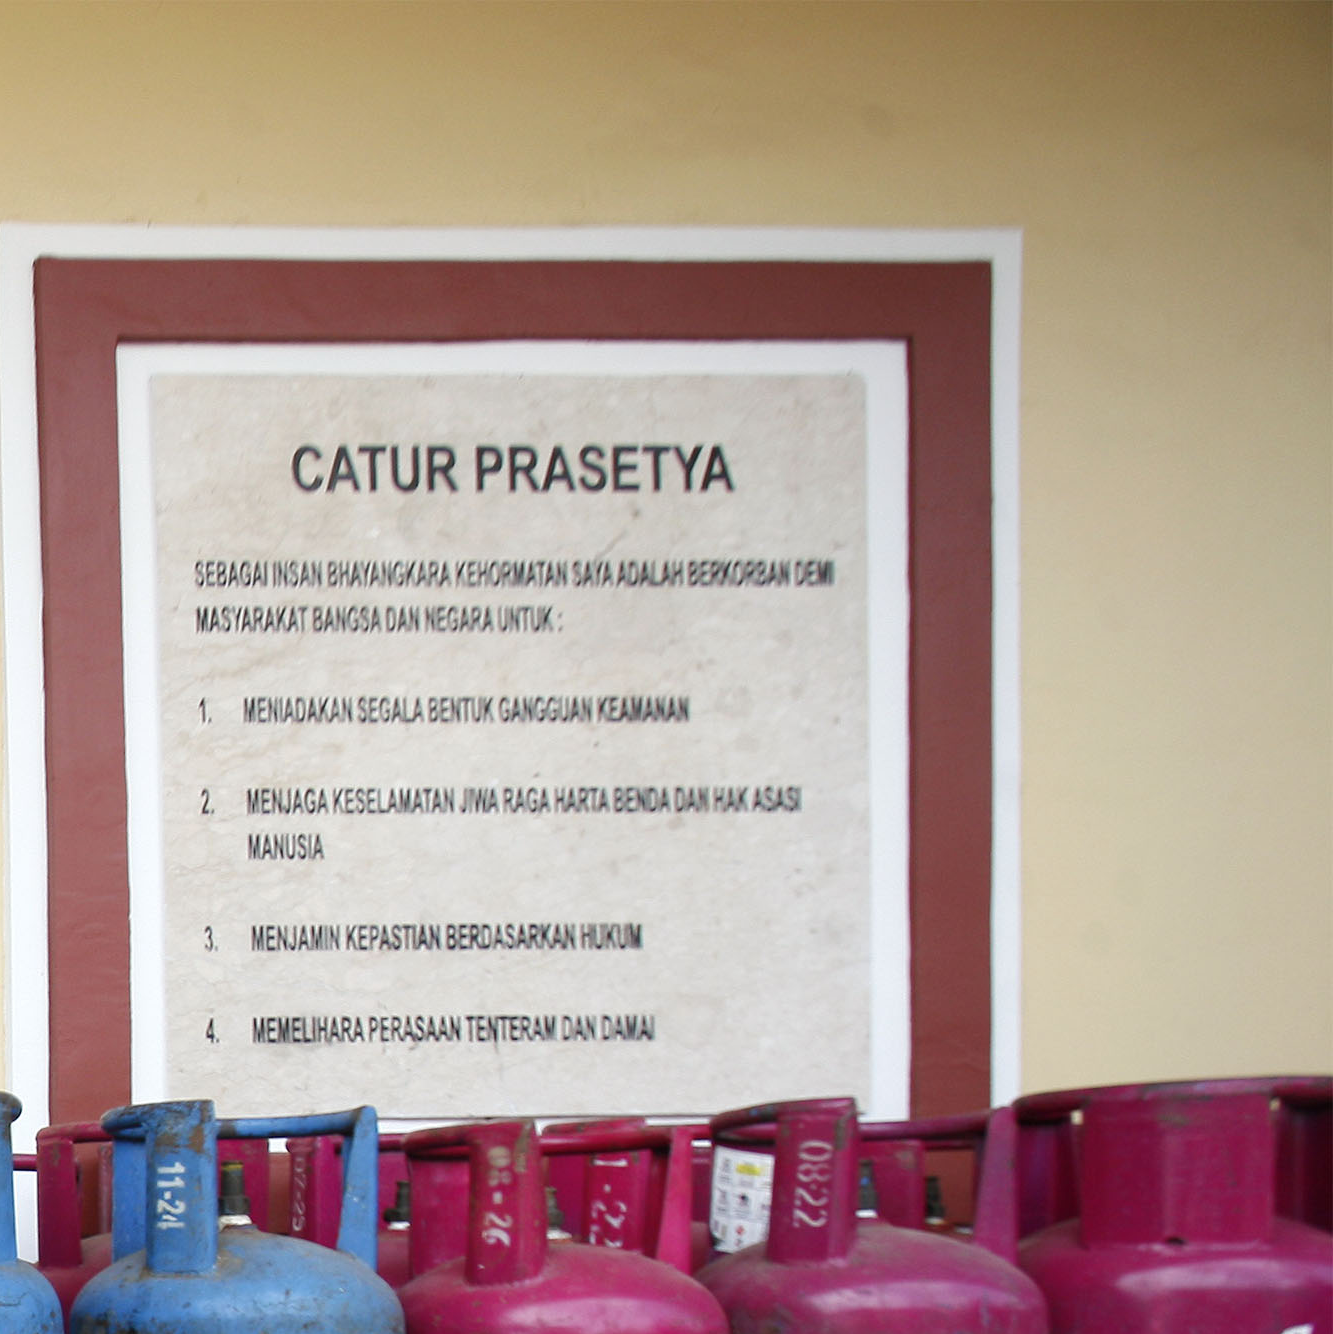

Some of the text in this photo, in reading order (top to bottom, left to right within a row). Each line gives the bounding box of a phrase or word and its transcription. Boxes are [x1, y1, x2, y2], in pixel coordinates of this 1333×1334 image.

[291, 444, 735, 493] CATUR PRASETYA
[194, 559, 836, 588] SEBAGAI INSAN BHAYANGKARA KEHORMATAN SAYA ADALAH BERKORBAN DEMI
[196, 606, 308, 633] MASYARAKAT
[312, 606, 382, 633] BANGSA
[385, 606, 420, 633] DAN
[425, 606, 494, 633] NEGARA
[497, 606, 554, 632] UNTUK
[197, 696, 690, 724] 1. MENIADAKAN SEGALA BENTUK GANGGUAN KEAMANAN
[201, 787, 803, 815] 2. MENJAGA KESELAMATAN JIWA RAGA HARTA BENDA DAN HAK ASASI
[248, 833, 325, 860] MANUSIA
[204, 923, 643, 952] 3. MENJAMIN KEPASTIAN BERDASARKAN HUKUM
[205, 1015, 655, 1044] 4. MEMELIHARA PERASAAN TENTERAM DAN DAMAI
[156, 1161, 186, 1231] 11-24
